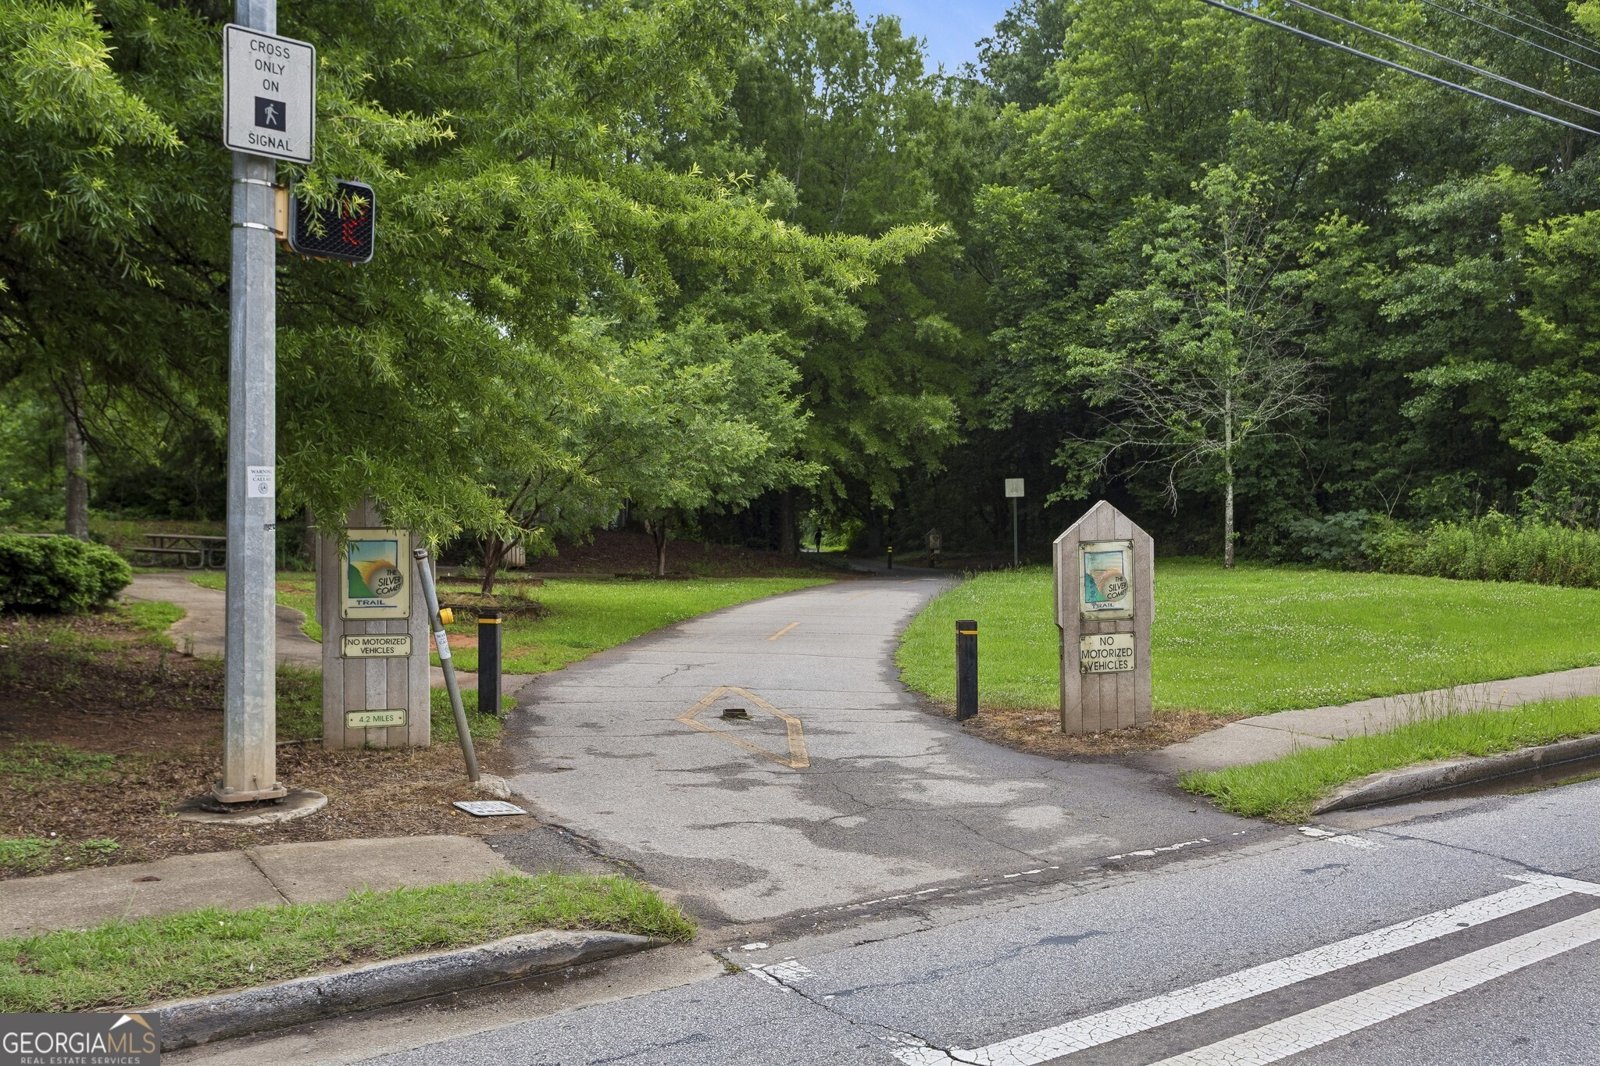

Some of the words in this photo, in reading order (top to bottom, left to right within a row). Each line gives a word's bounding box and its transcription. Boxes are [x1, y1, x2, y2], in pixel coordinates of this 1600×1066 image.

[250, 39, 290, 59] CROSS
[254, 59, 285, 76] ONLY
[262, 79, 279, 93] ON
[248, 132, 293, 152] SIGNAL
[378, 576, 401, 587] SILVER
[1108, 581, 1127, 593] SILVER
[376, 584, 401, 595] COMET
[1107, 588, 1127, 600] COMET
[347, 638, 360, 646] NO
[362, 637, 407, 646] MOTORIZED
[1100, 636, 1114, 646] NO
[360, 647, 395, 655] VEHICLES
[1081, 647, 1133, 659] MOTORIZED
[1087, 660, 1128, 671] VEHICLES
[359, 715, 371, 723] 4.2
